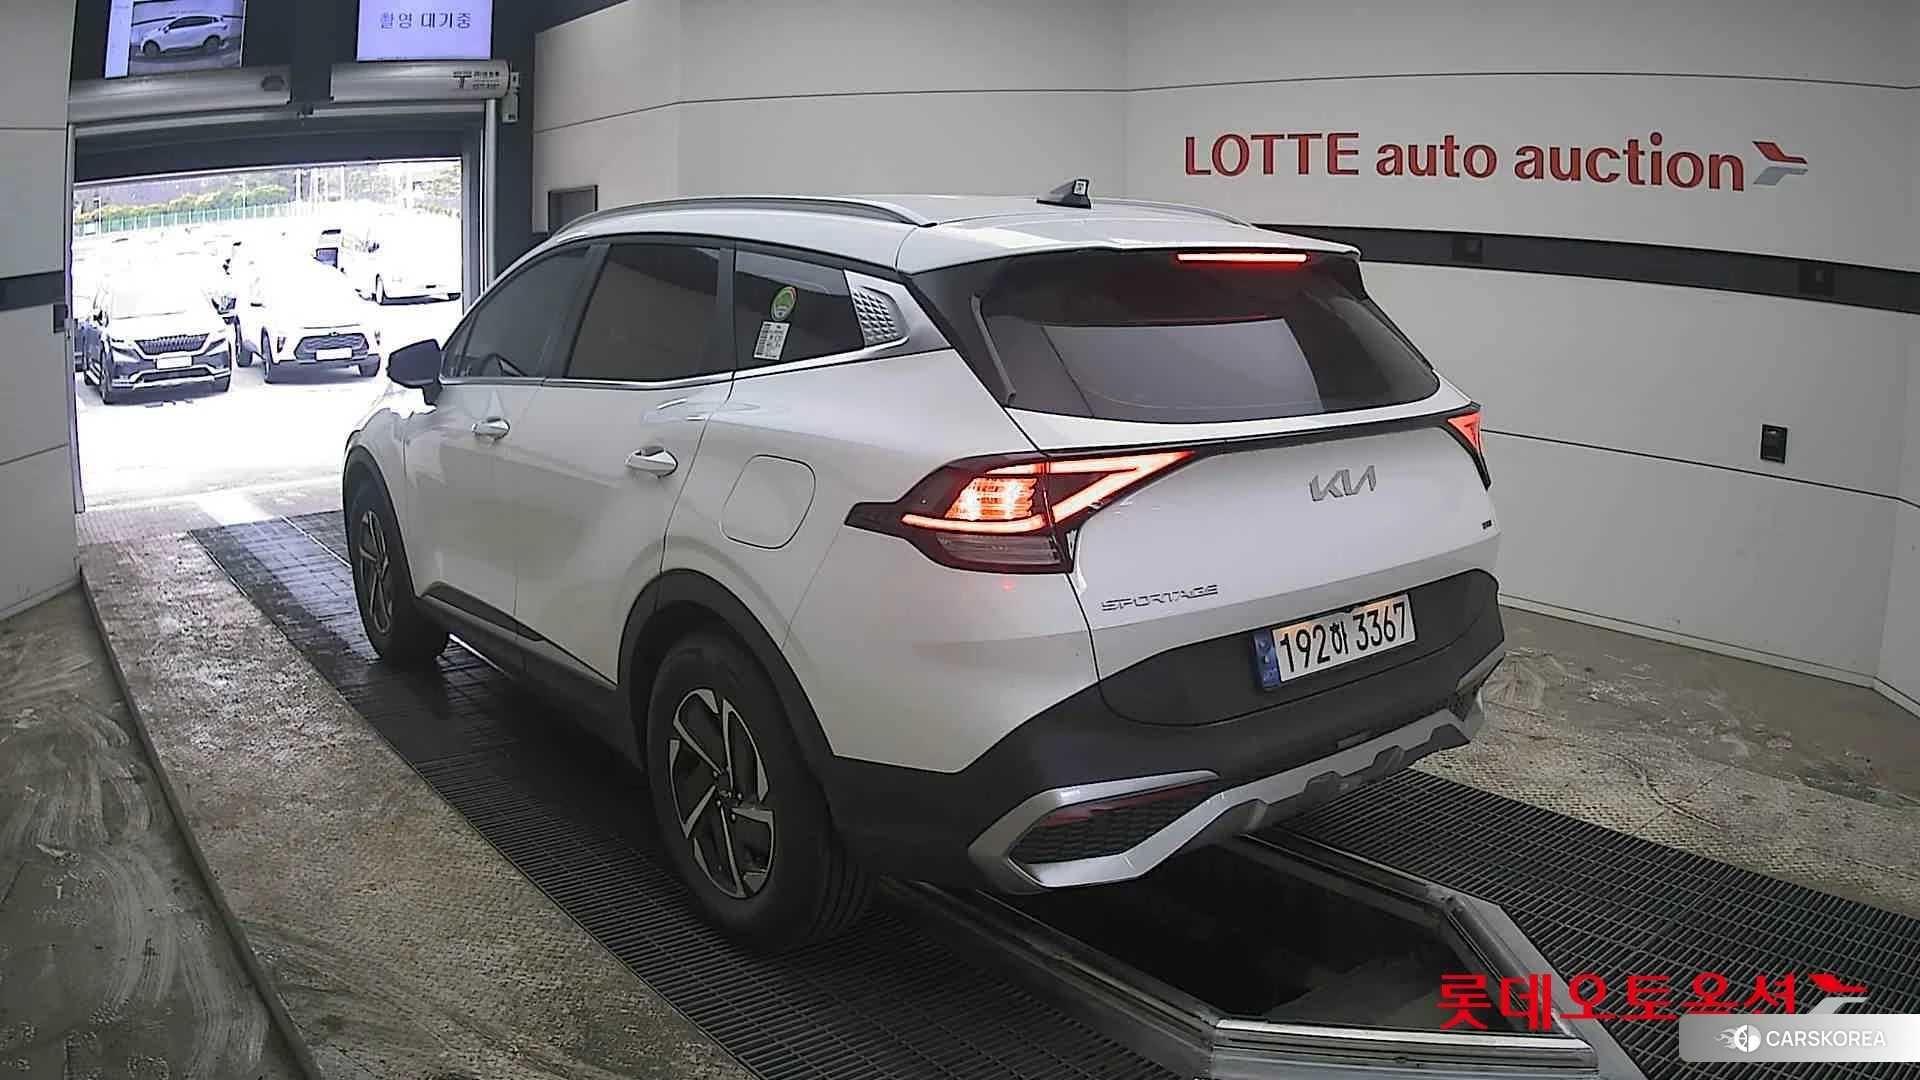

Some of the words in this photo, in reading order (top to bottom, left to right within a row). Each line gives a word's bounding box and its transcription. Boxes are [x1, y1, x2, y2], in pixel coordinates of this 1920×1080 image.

[420, 12, 472, 30] 대기중
[1184, 132, 1360, 177] LOTTE
[1375, 135, 1498, 179] auto
[1513, 132, 1746, 192] auction
[1309, 464, 1377, 502] KIA
[1101, 584, 1218, 611] SPORTAGE
[1279, 620, 1349, 673] 192하
[1352, 601, 1406, 651] 3367
